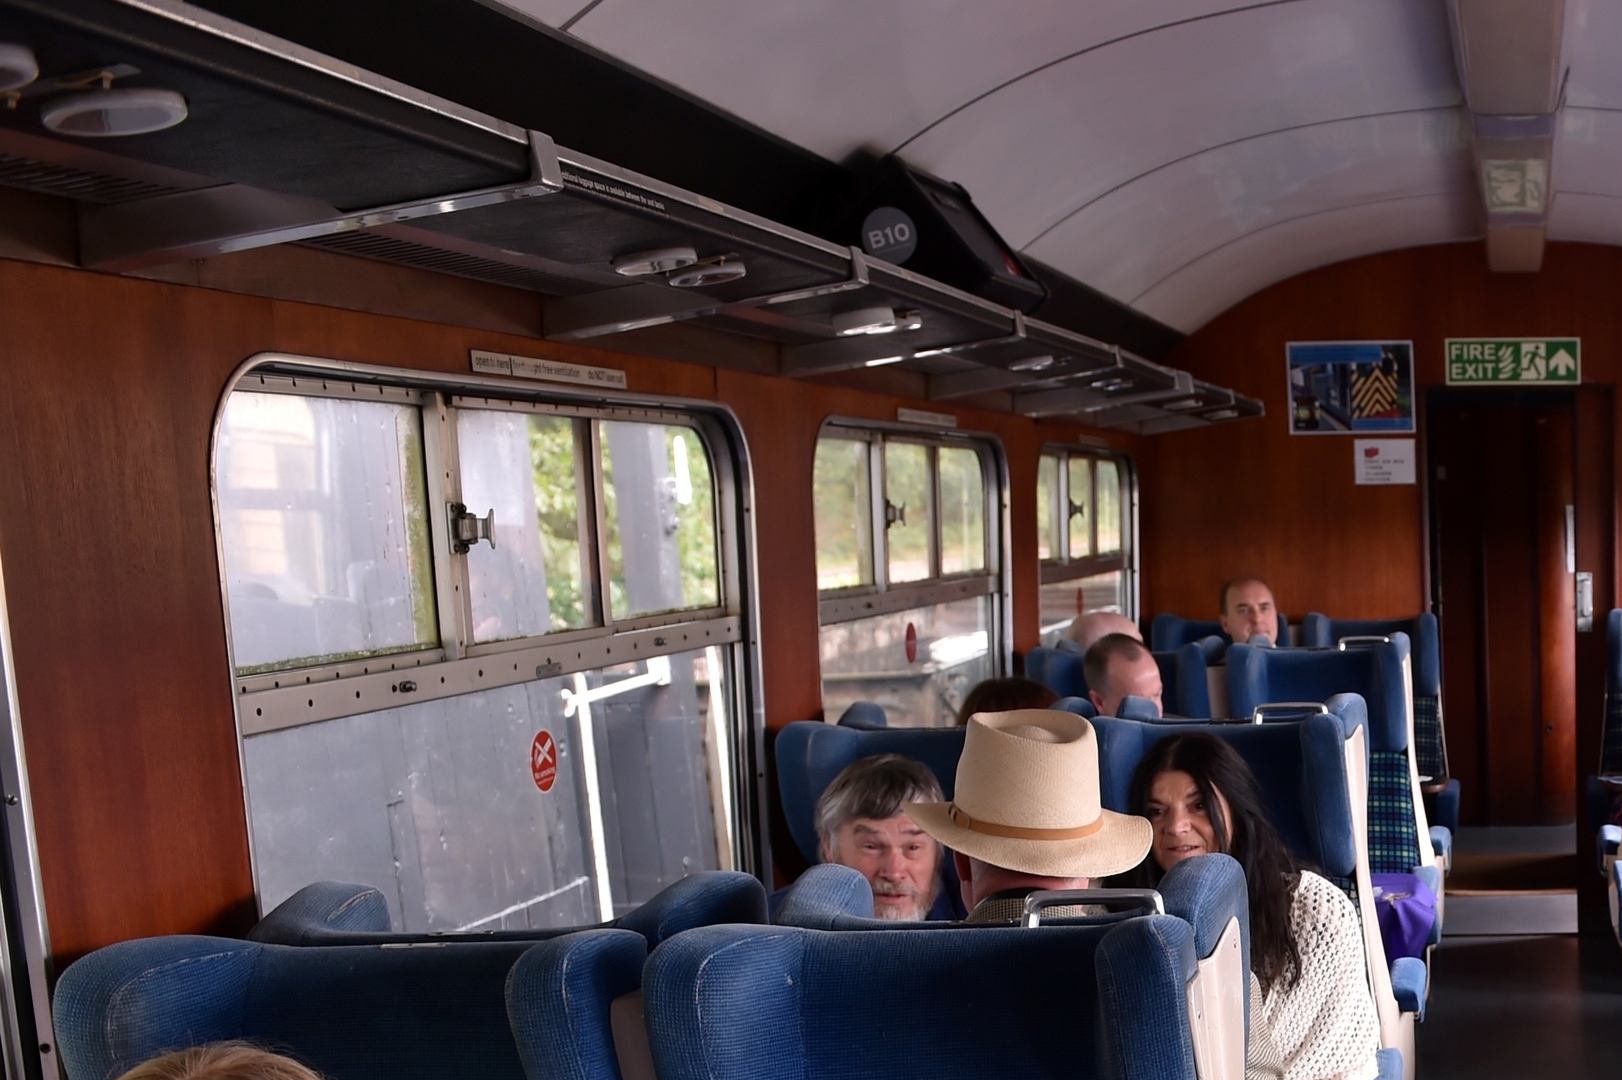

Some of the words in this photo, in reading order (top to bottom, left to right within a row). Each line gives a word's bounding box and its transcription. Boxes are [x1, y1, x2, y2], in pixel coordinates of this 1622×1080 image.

[560, 169, 578, 183] dditional
[867, 222, 910, 249] B10
[1450, 343, 1497, 360] FIRE
[1451, 362, 1497, 380] EXIT
